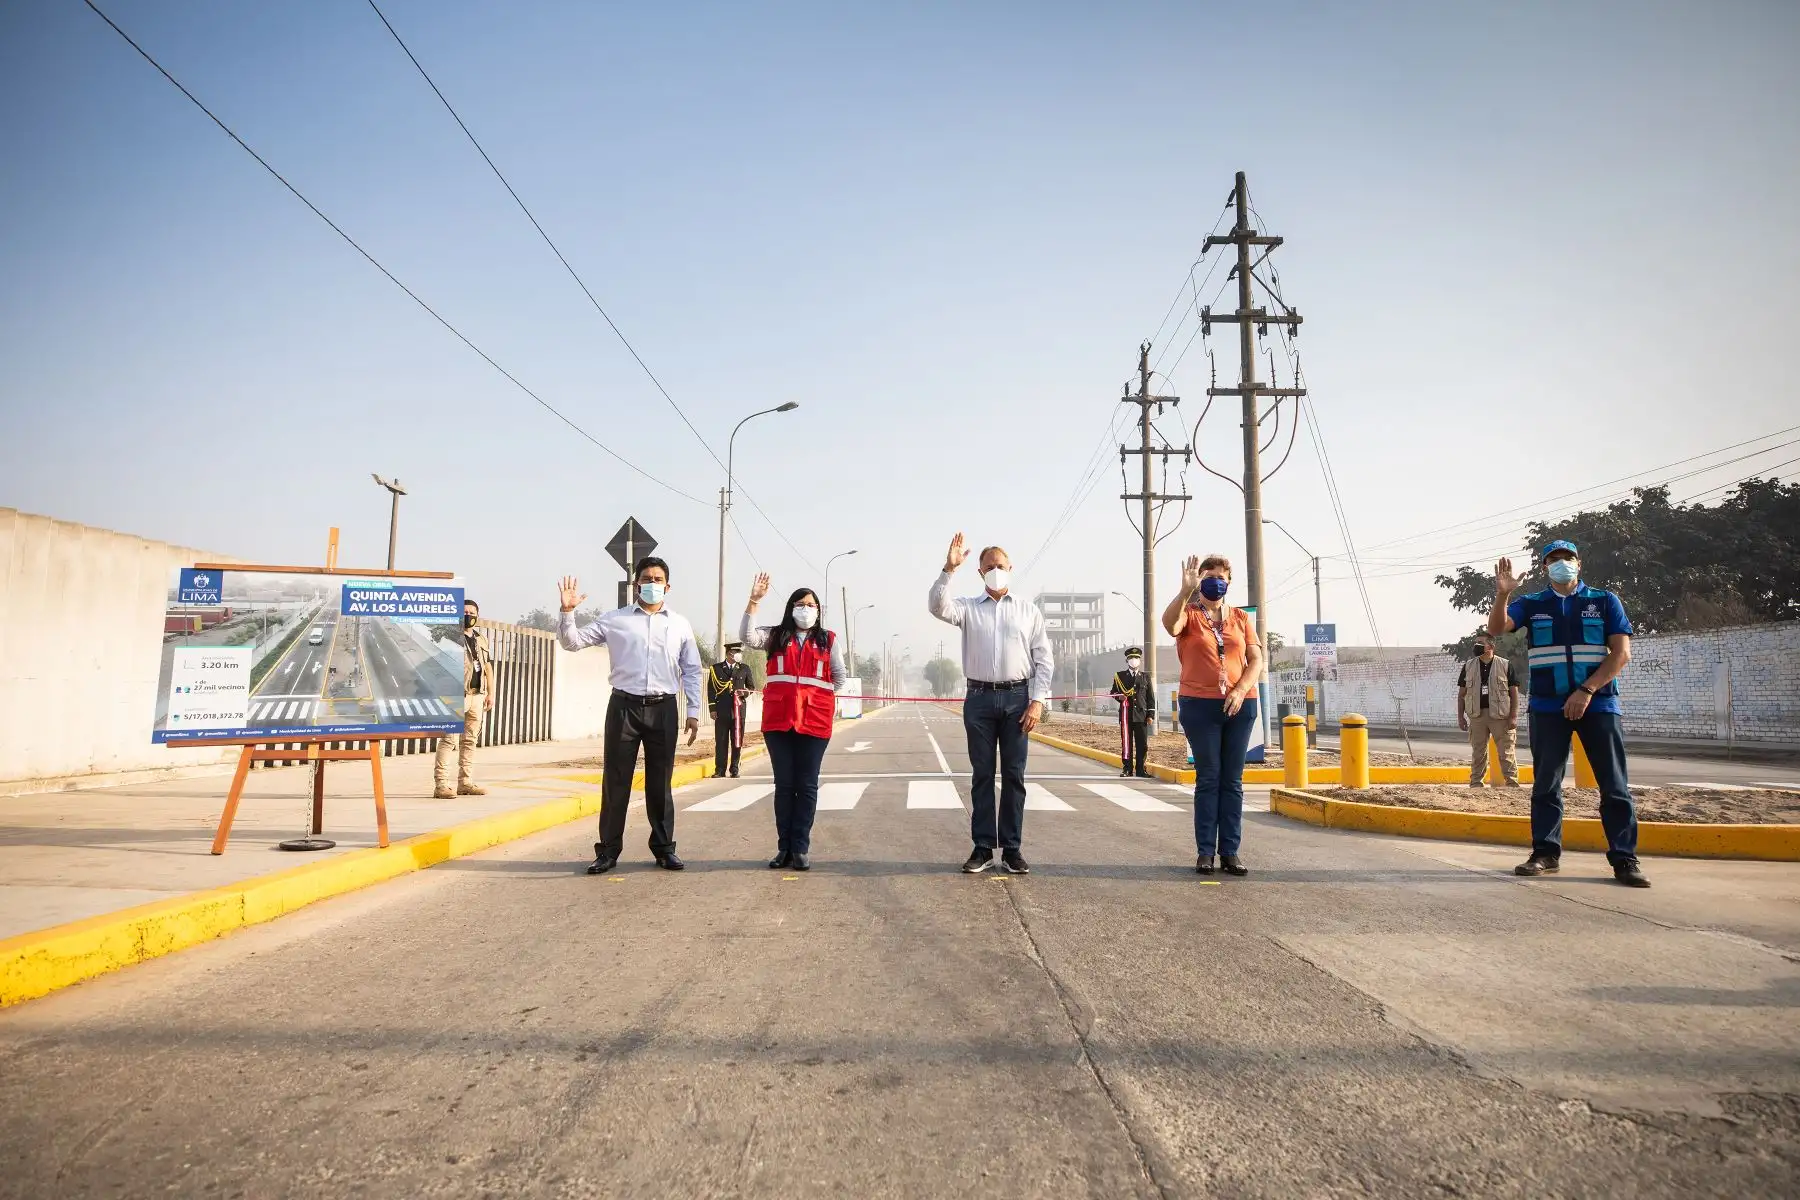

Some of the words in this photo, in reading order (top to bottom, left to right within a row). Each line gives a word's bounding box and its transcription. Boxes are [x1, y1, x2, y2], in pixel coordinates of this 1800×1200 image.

[181, 592, 218, 602] LIMA
[349, 590, 399, 602] QUINTA
[401, 592, 455, 603] AVENIDA
[349, 603, 369, 613] AV.
[372, 603, 396, 613] LOS
[399, 604, 458, 614] LAURELES
[201, 661, 222, 669] 3.20
[224, 661, 239, 669] km
